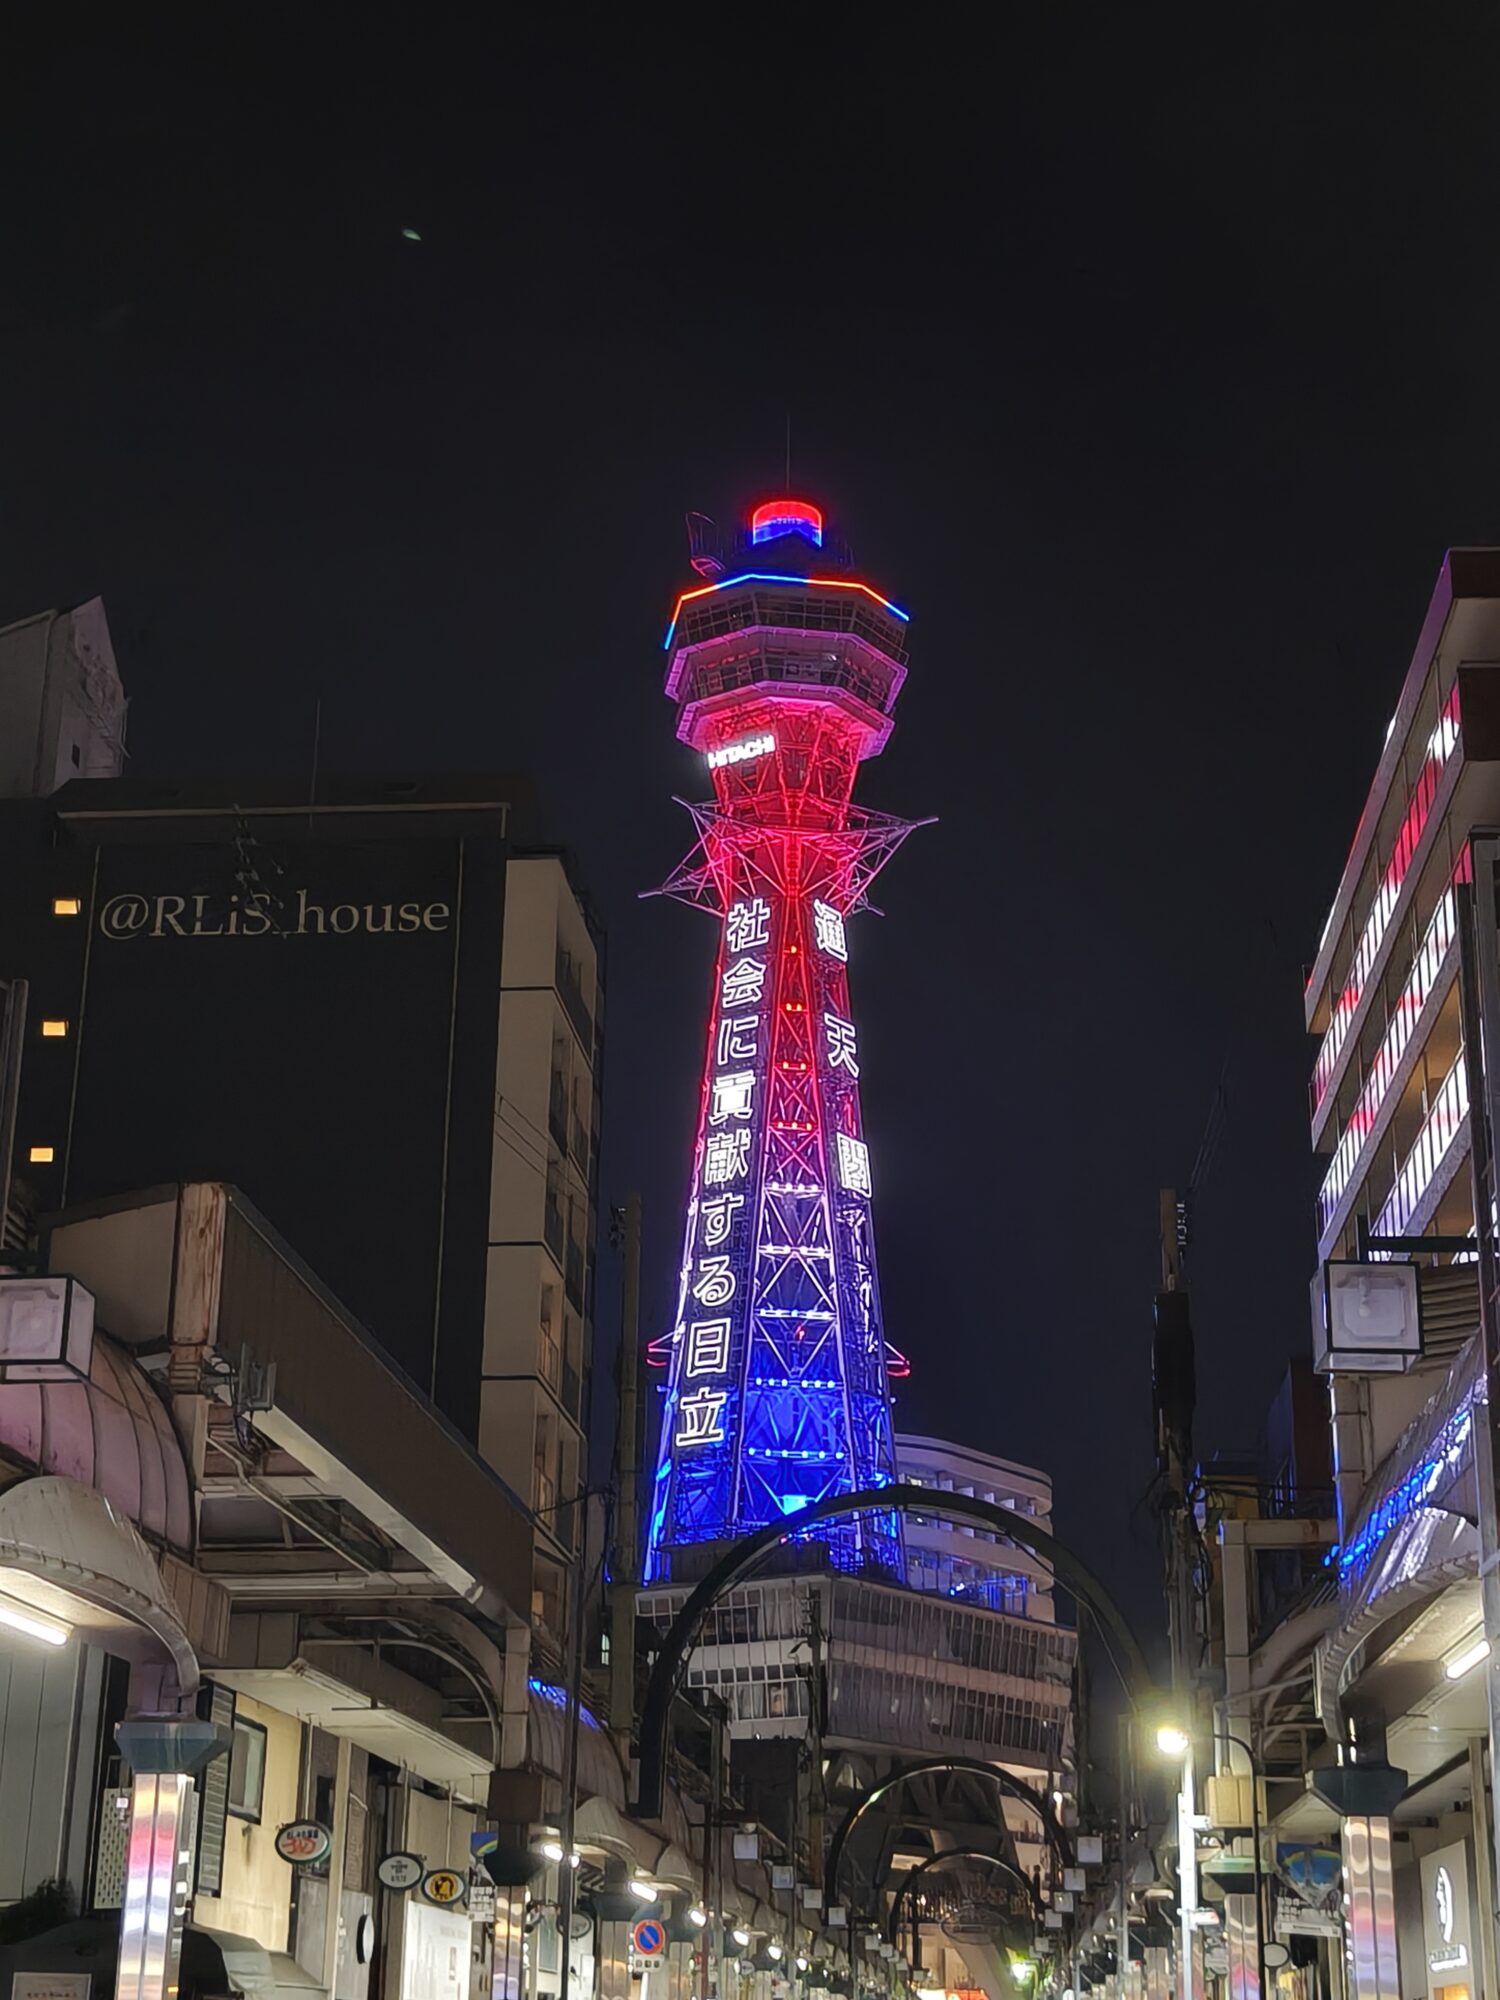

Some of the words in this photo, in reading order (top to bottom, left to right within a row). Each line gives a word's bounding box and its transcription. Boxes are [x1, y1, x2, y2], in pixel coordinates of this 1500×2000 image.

[708, 734, 776, 769] HITACHI
[675, 899, 771, 1447] 社会に貢献する日立
[813, 899, 873, 1198] 通天閣
